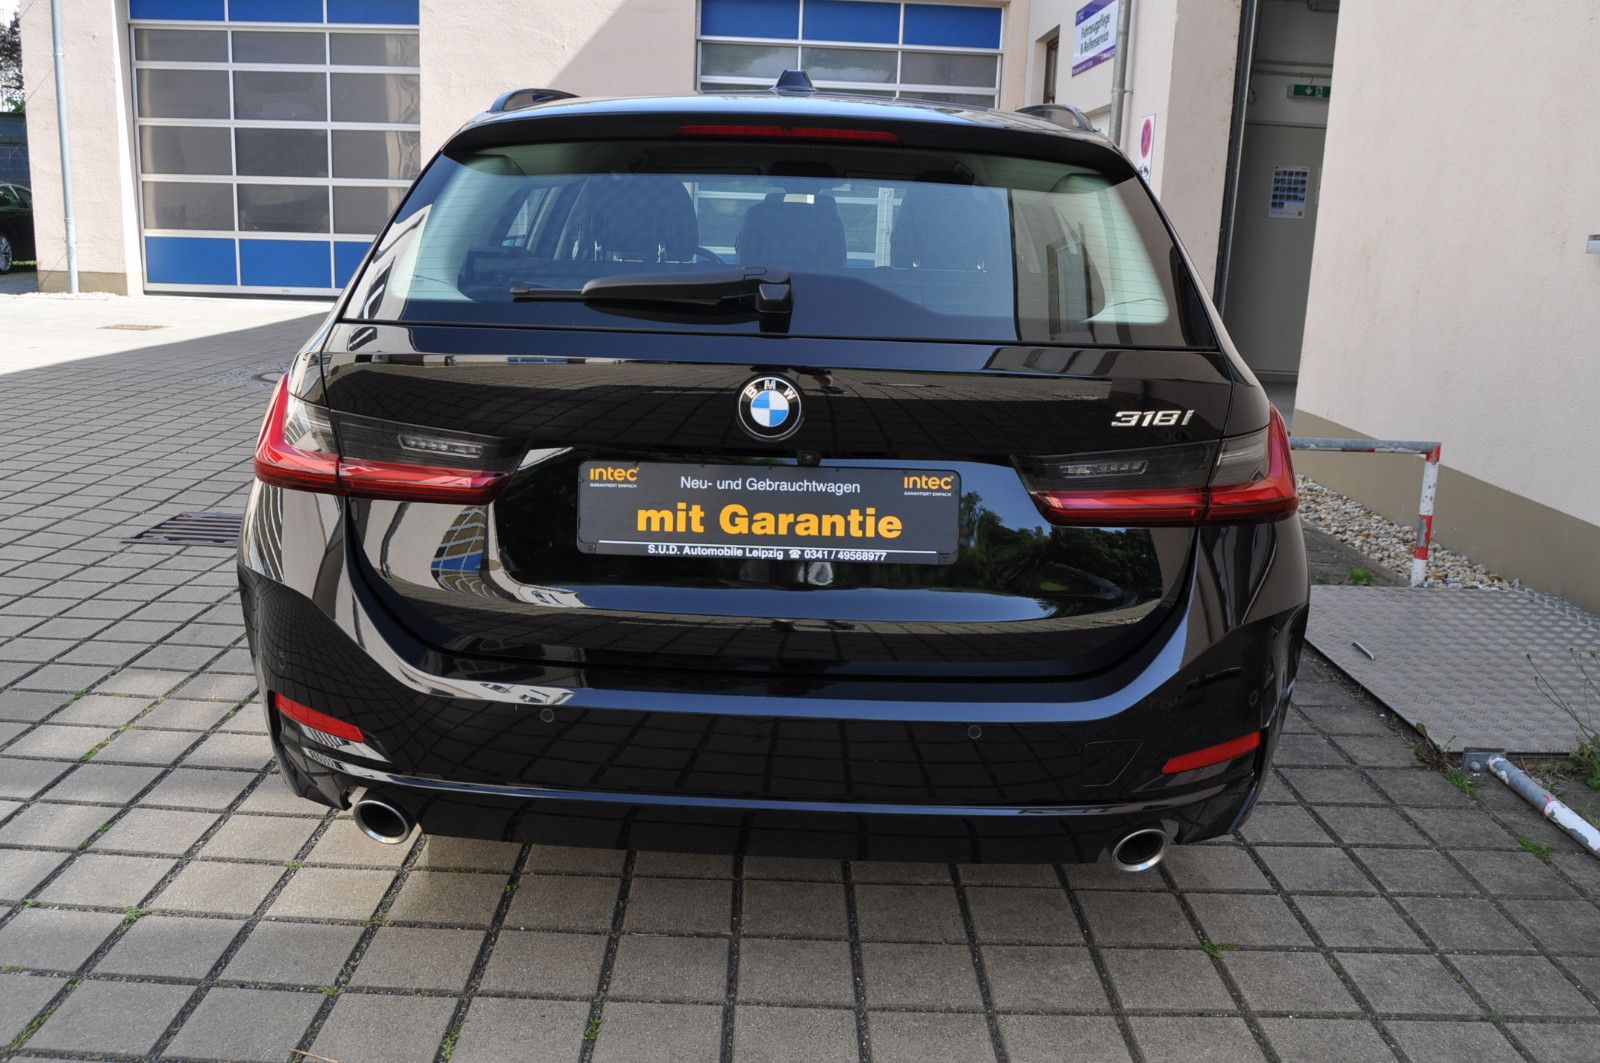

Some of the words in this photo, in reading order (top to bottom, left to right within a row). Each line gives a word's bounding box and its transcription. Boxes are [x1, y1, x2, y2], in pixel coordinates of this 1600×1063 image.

[744, 379, 796, 400] BMW
[589, 466, 639, 481] intec
[903, 475, 953, 490] intec
[680, 476, 713, 489] Neu-
[716, 478, 742, 490] und
[745, 478, 861, 496] Gebrauchtwagen
[636, 502, 705, 533] mit
[719, 504, 903, 539] Garantie
[647, 544, 680, 555] S.U.D.
[683, 545, 744, 557] Automobile
[745, 547, 784, 560] Leipzig
[804, 550, 829, 560] 0341
[837, 552, 888, 562] 49568977
